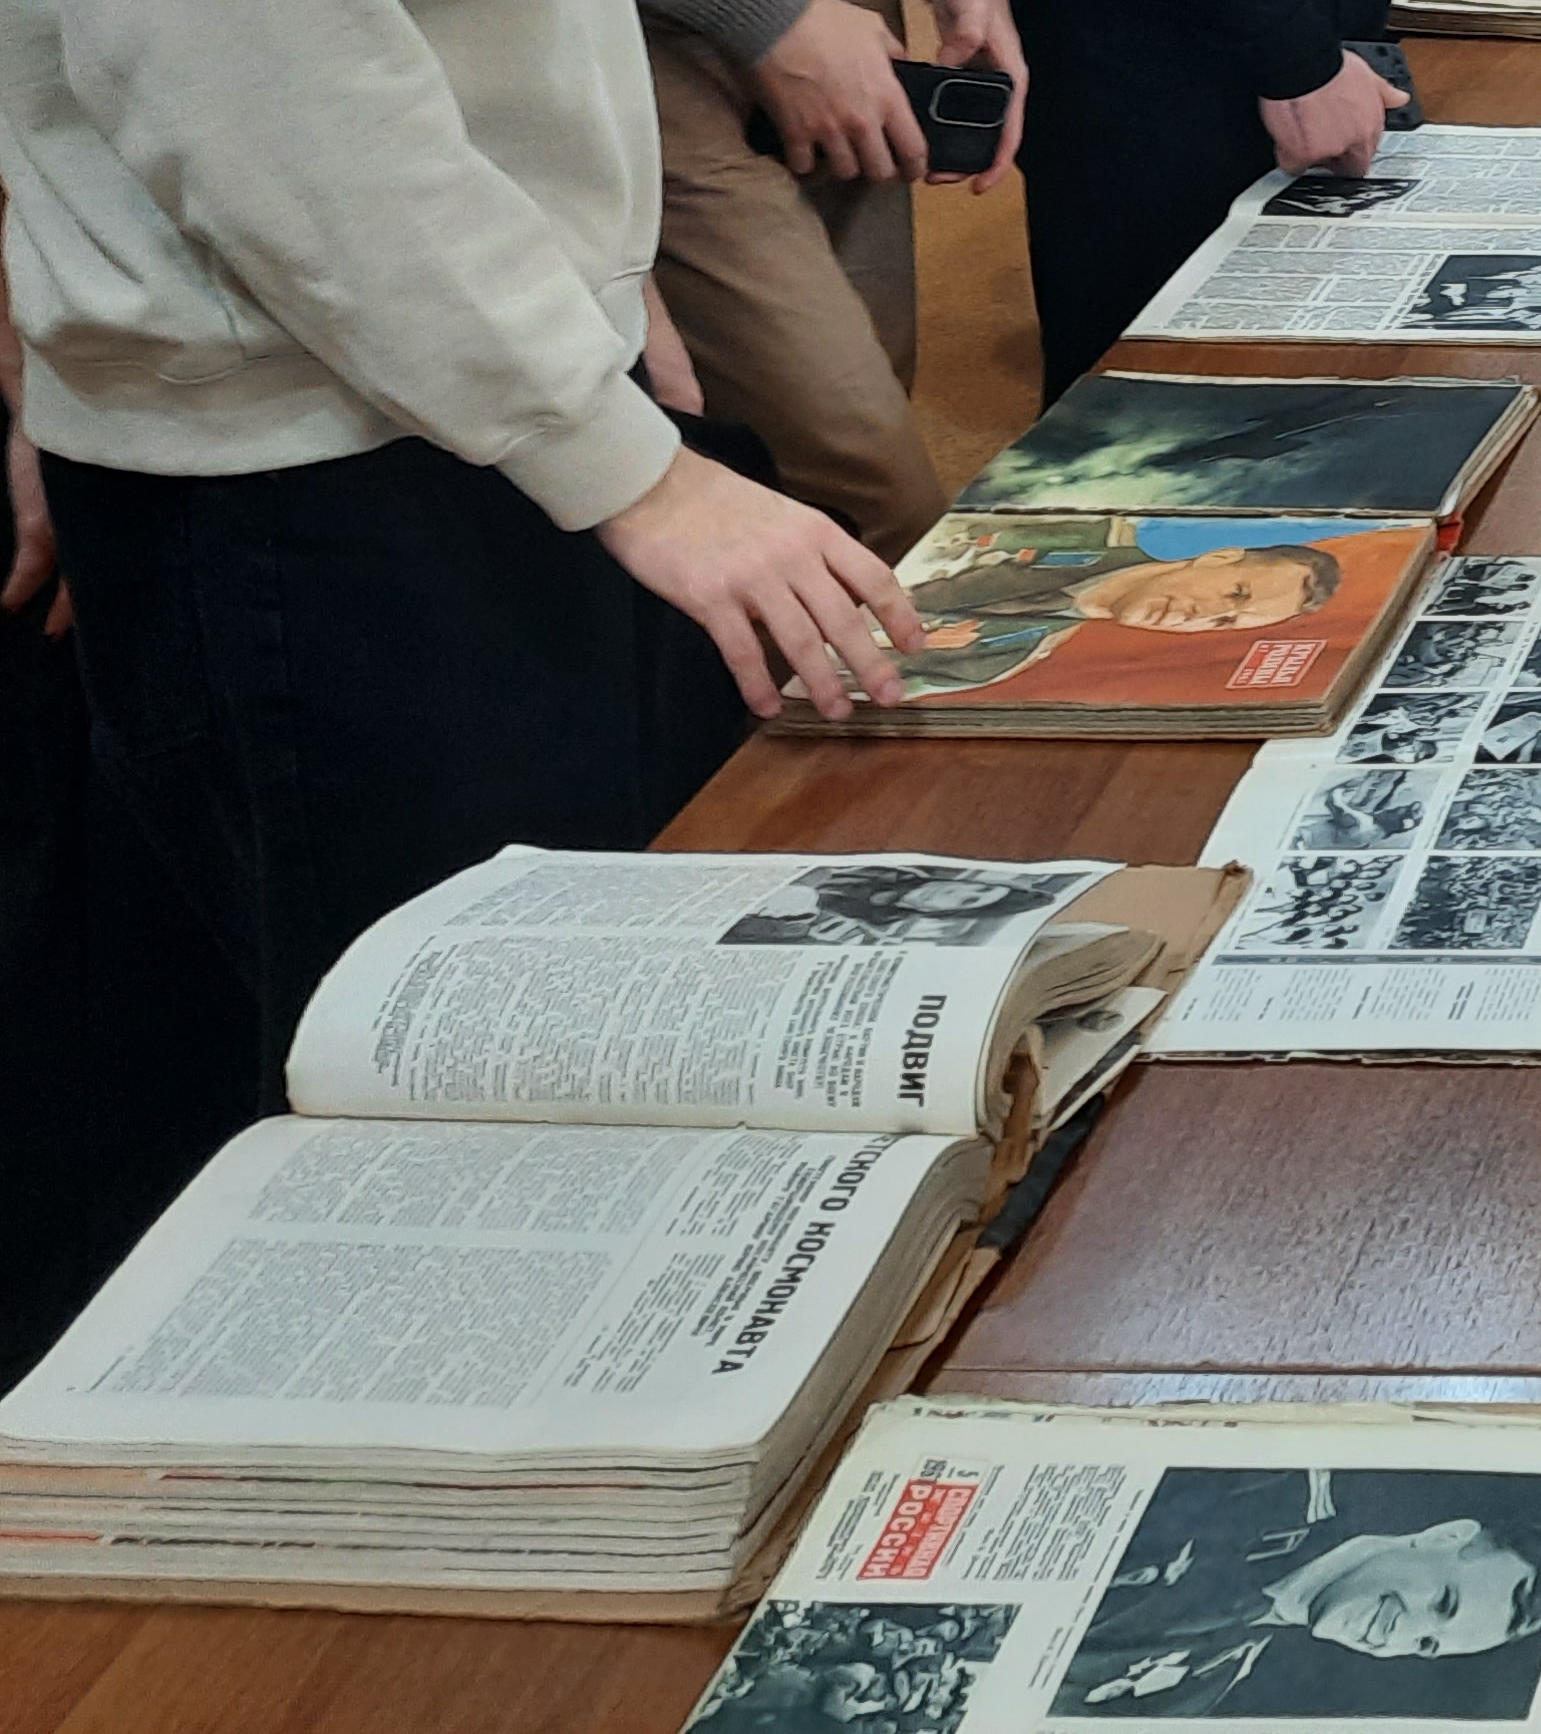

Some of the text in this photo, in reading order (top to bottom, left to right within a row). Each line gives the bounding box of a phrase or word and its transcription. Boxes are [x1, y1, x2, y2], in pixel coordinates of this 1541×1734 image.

[897, 994, 947, 1107] ПОДВИГ
[711, 1221, 836, 1375] КОСМОНАВТА
[863, 1484, 932, 1577] РОССИИ
